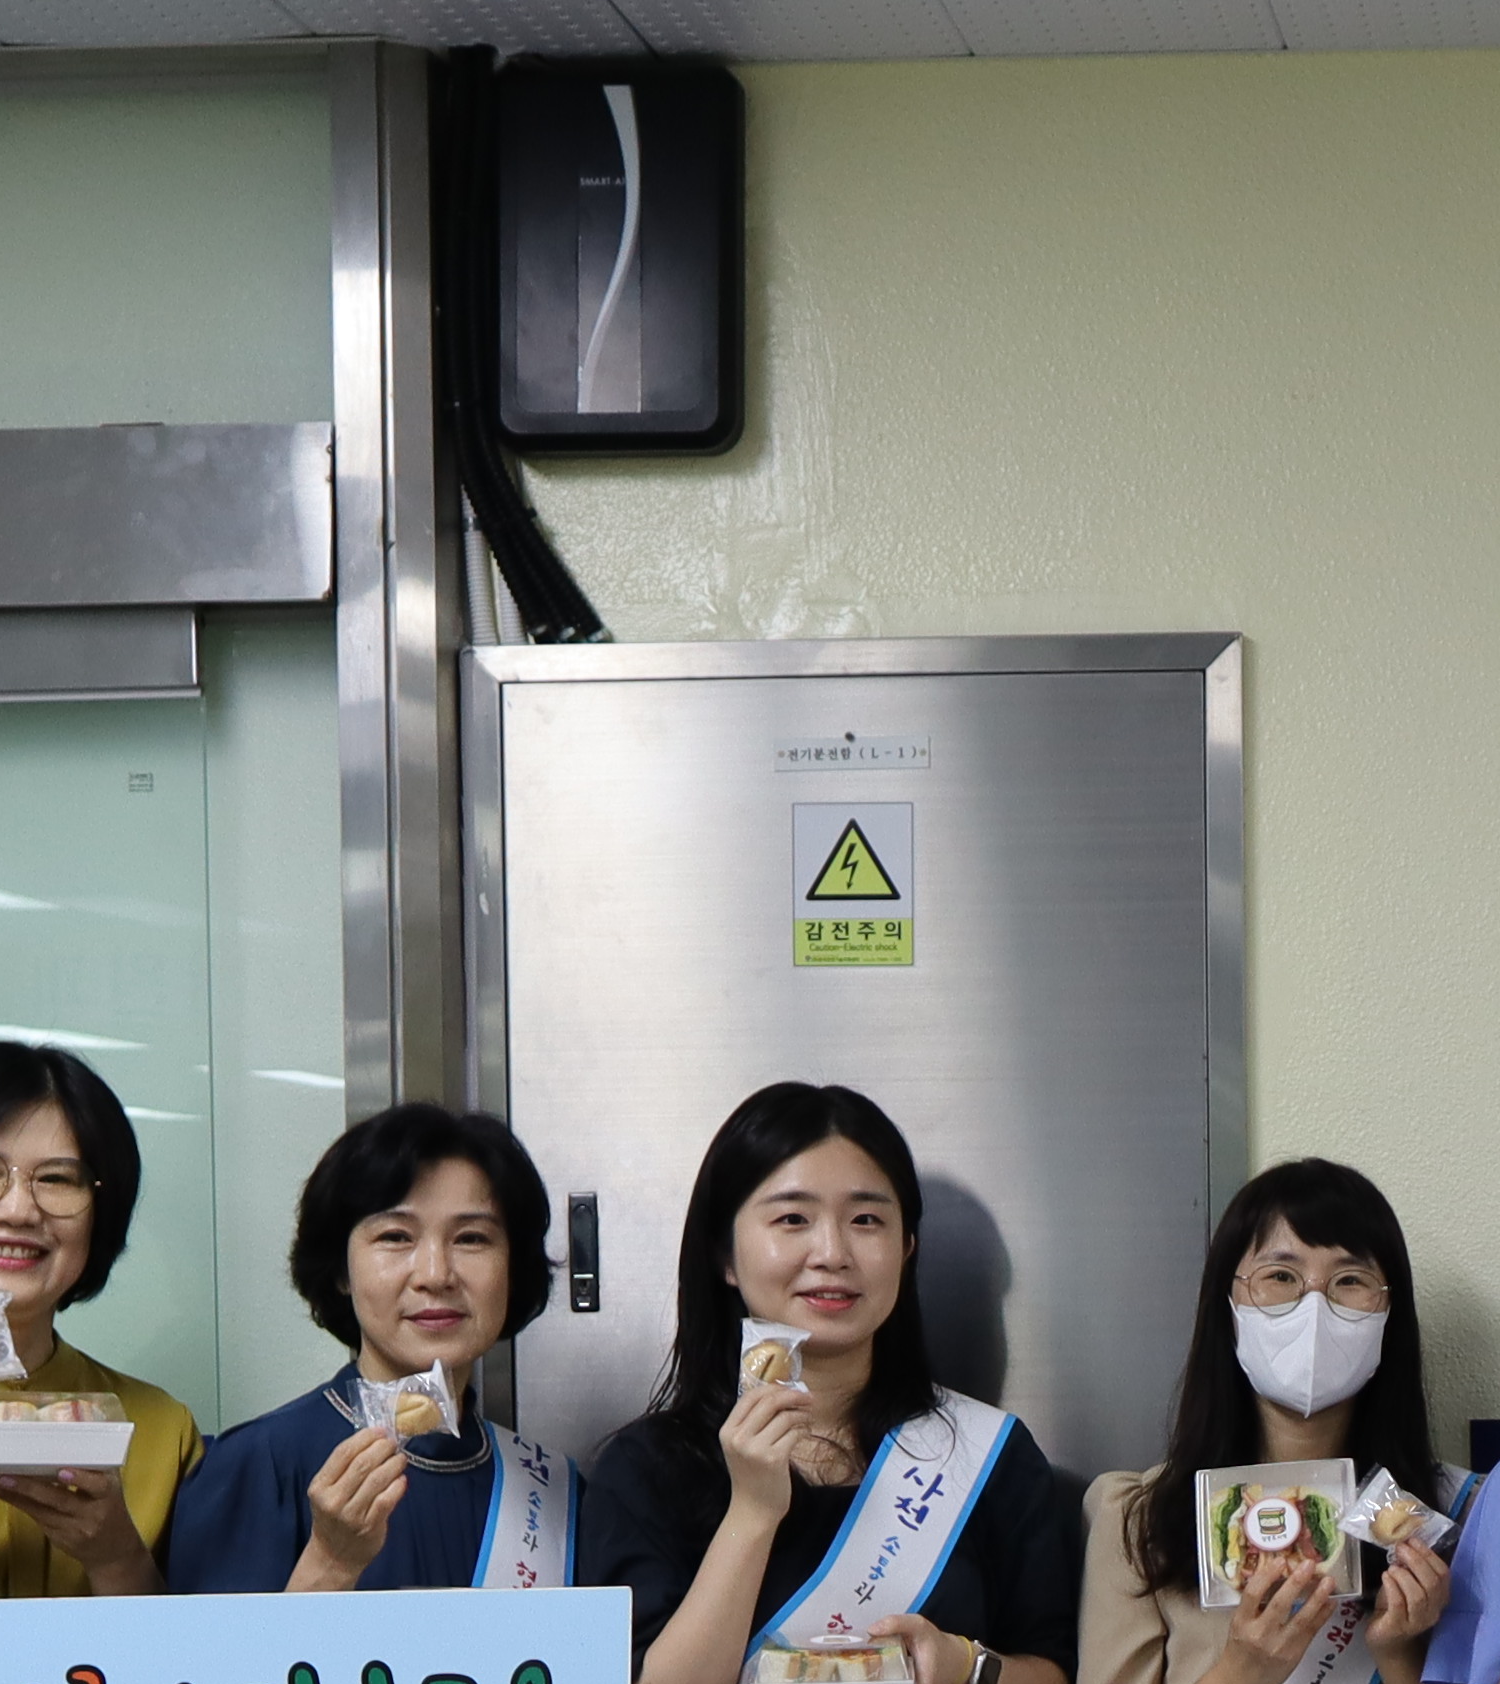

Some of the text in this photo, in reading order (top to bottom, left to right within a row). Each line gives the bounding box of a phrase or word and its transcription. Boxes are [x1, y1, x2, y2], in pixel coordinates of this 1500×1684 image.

[805, 920, 902, 941] 감전주의
[875, 942, 898, 952] shock
[854, 1467, 944, 1605] 사천 소통과
